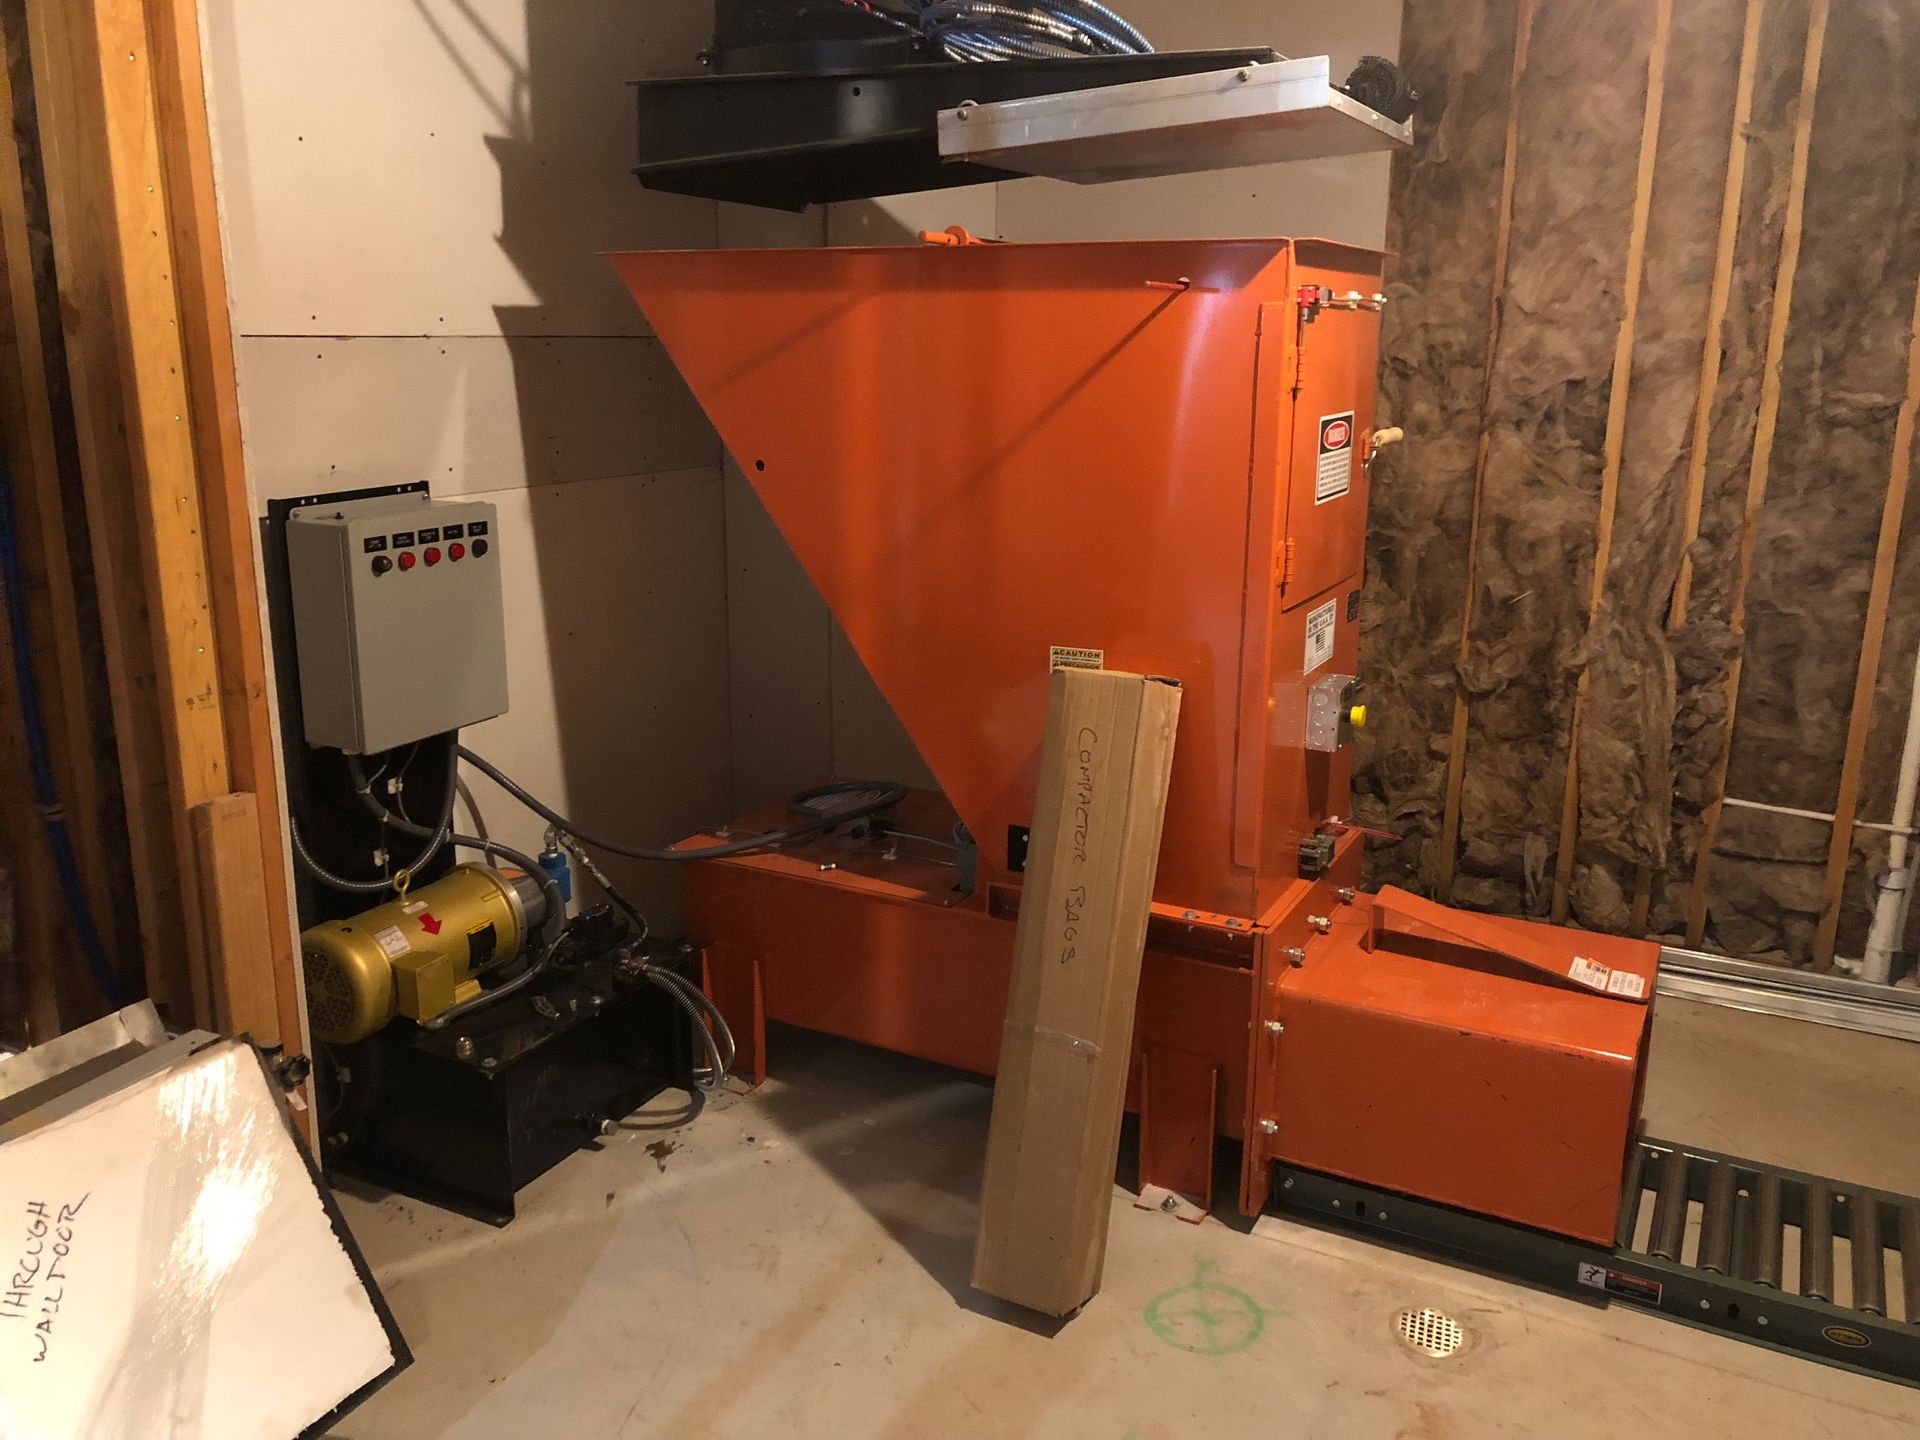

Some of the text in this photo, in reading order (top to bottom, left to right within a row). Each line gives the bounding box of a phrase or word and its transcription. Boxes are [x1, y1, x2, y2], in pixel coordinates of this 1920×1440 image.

[1059, 649, 1100, 659] CAUTION
[1061, 727, 1098, 965] COMPACTOR BAGS
[33, 1287, 64, 1363] WALL
